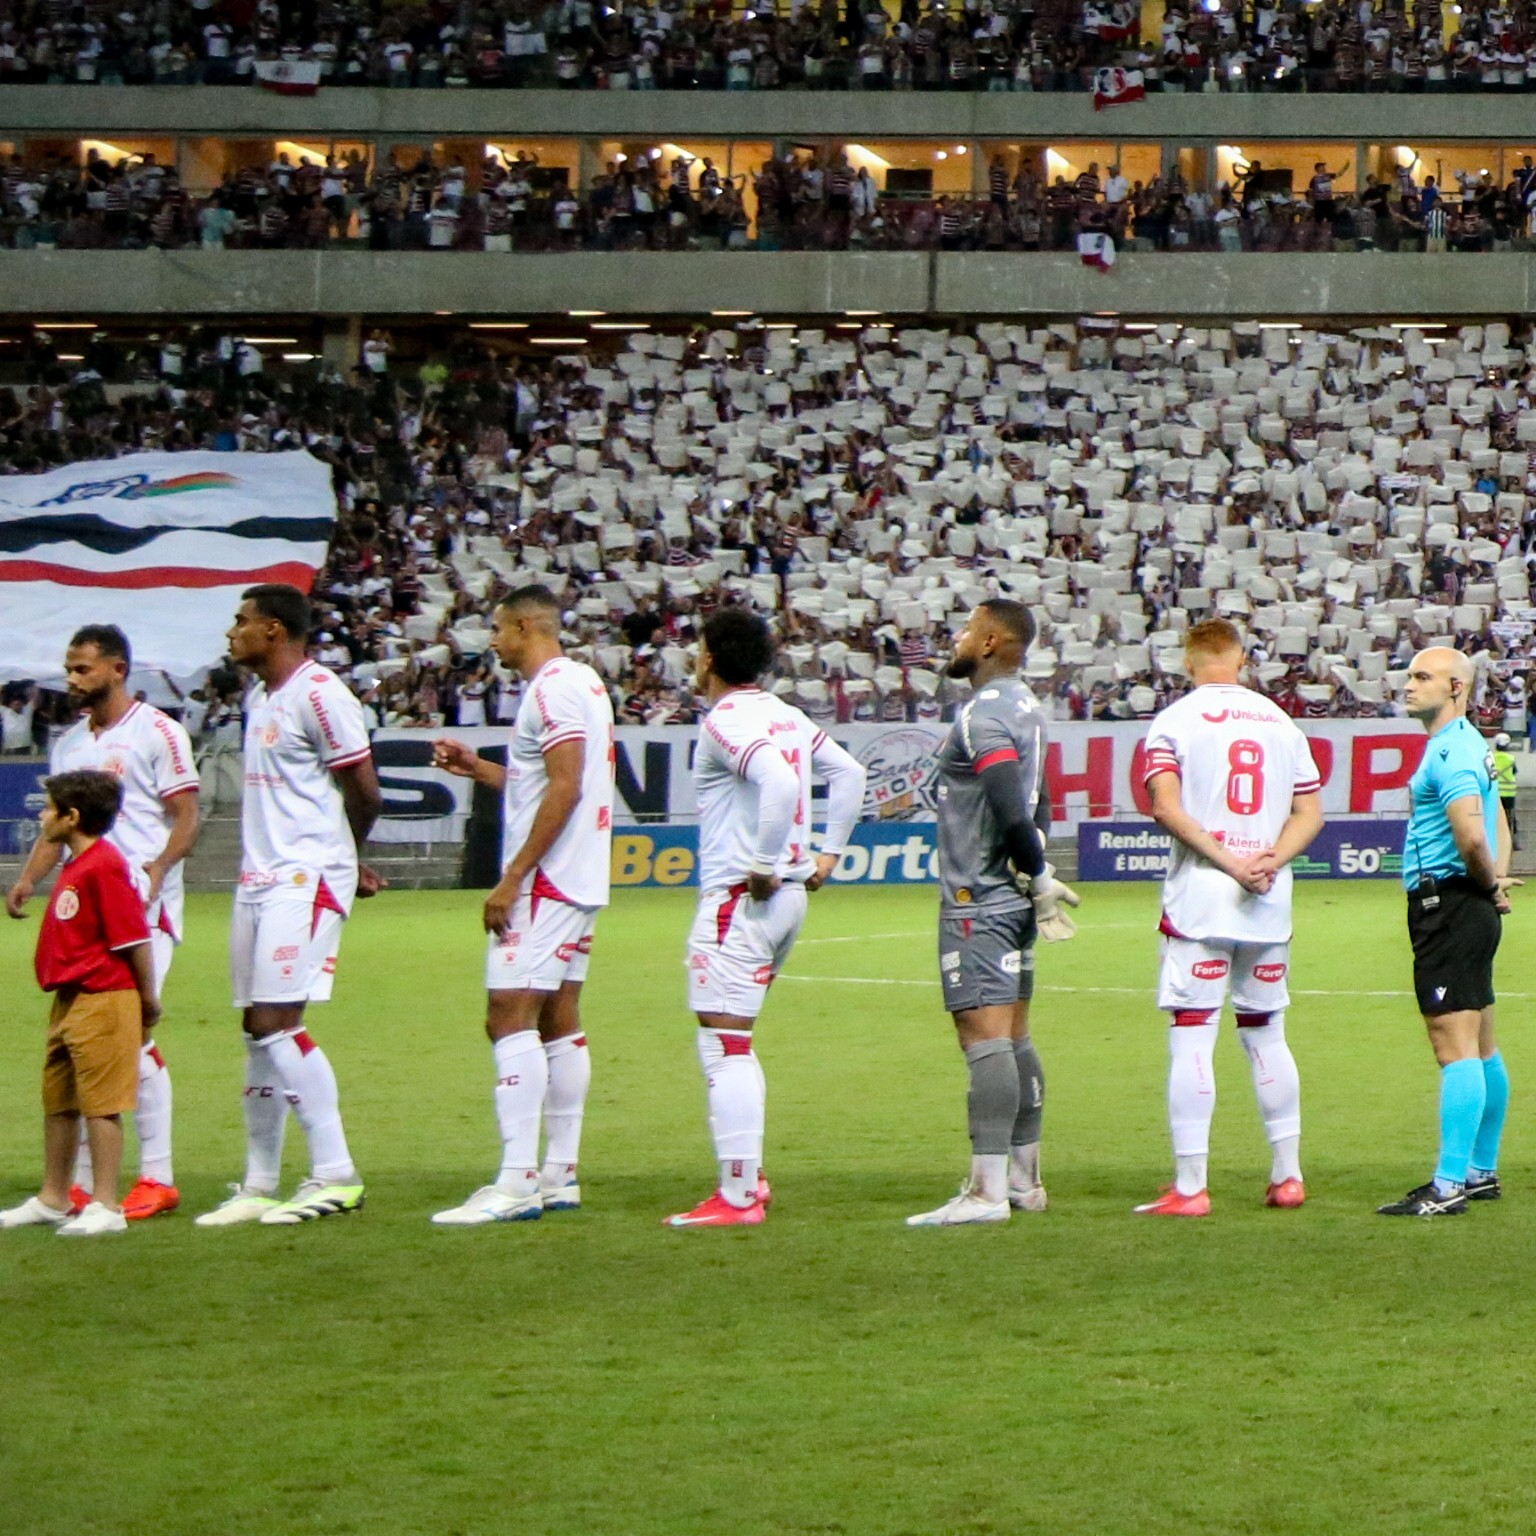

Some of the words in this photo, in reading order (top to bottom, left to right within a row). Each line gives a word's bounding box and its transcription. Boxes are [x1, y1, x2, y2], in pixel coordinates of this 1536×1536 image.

[309, 690, 341, 751] Unimed
[155, 720, 188, 775] Unimed
[1227, 739, 1264, 814] 8
[612, 834, 695, 885] Be
[830, 836, 940, 881] ort
[1340, 848, 1380, 873] 50
